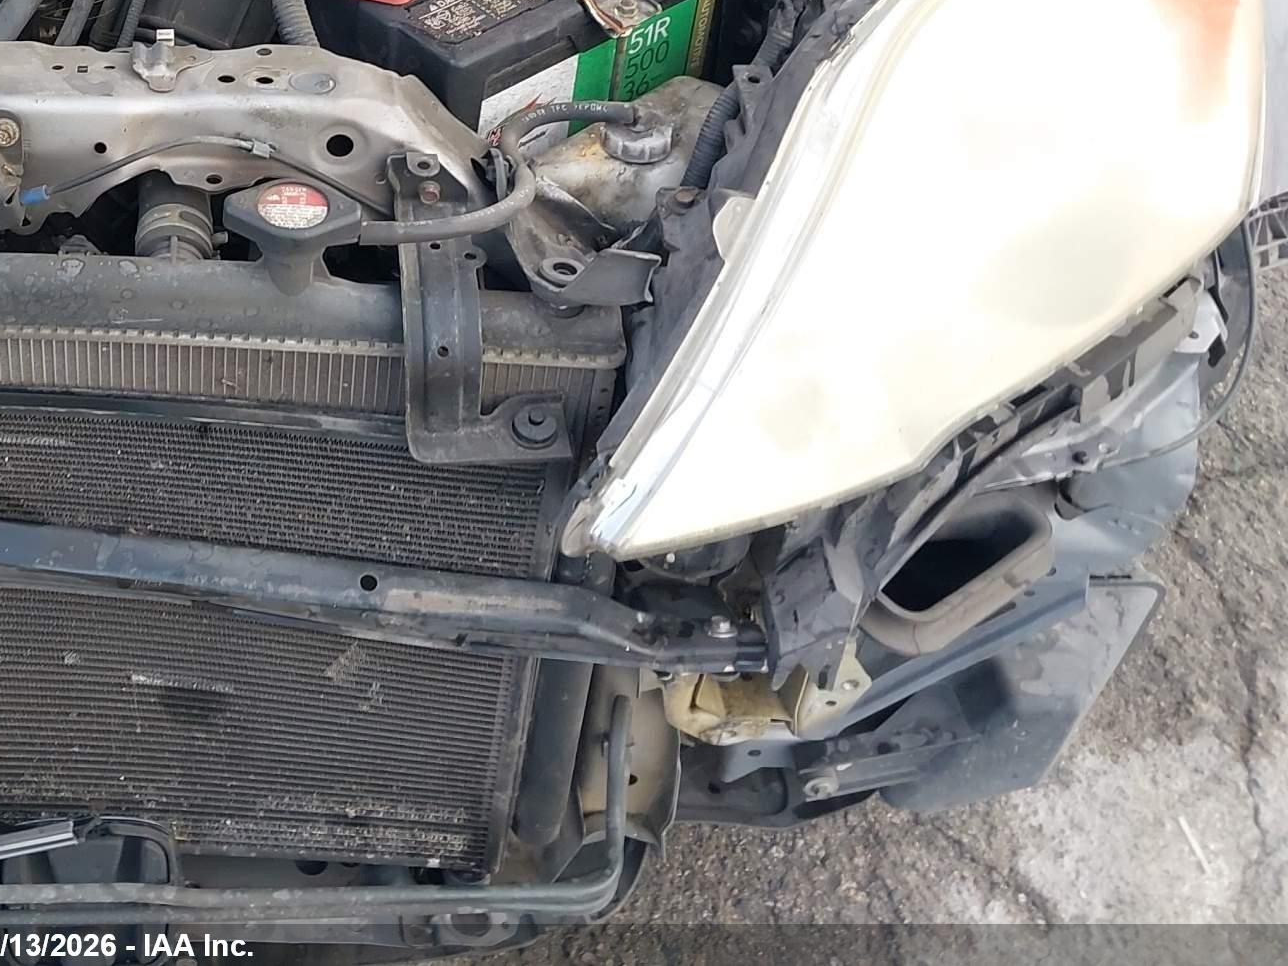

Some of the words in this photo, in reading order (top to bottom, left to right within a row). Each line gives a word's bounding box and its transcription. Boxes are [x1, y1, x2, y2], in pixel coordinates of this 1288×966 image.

[628, 16, 672, 54] 51R
[624, 40, 670, 79] 500
[623, 73, 663, 101] 36
